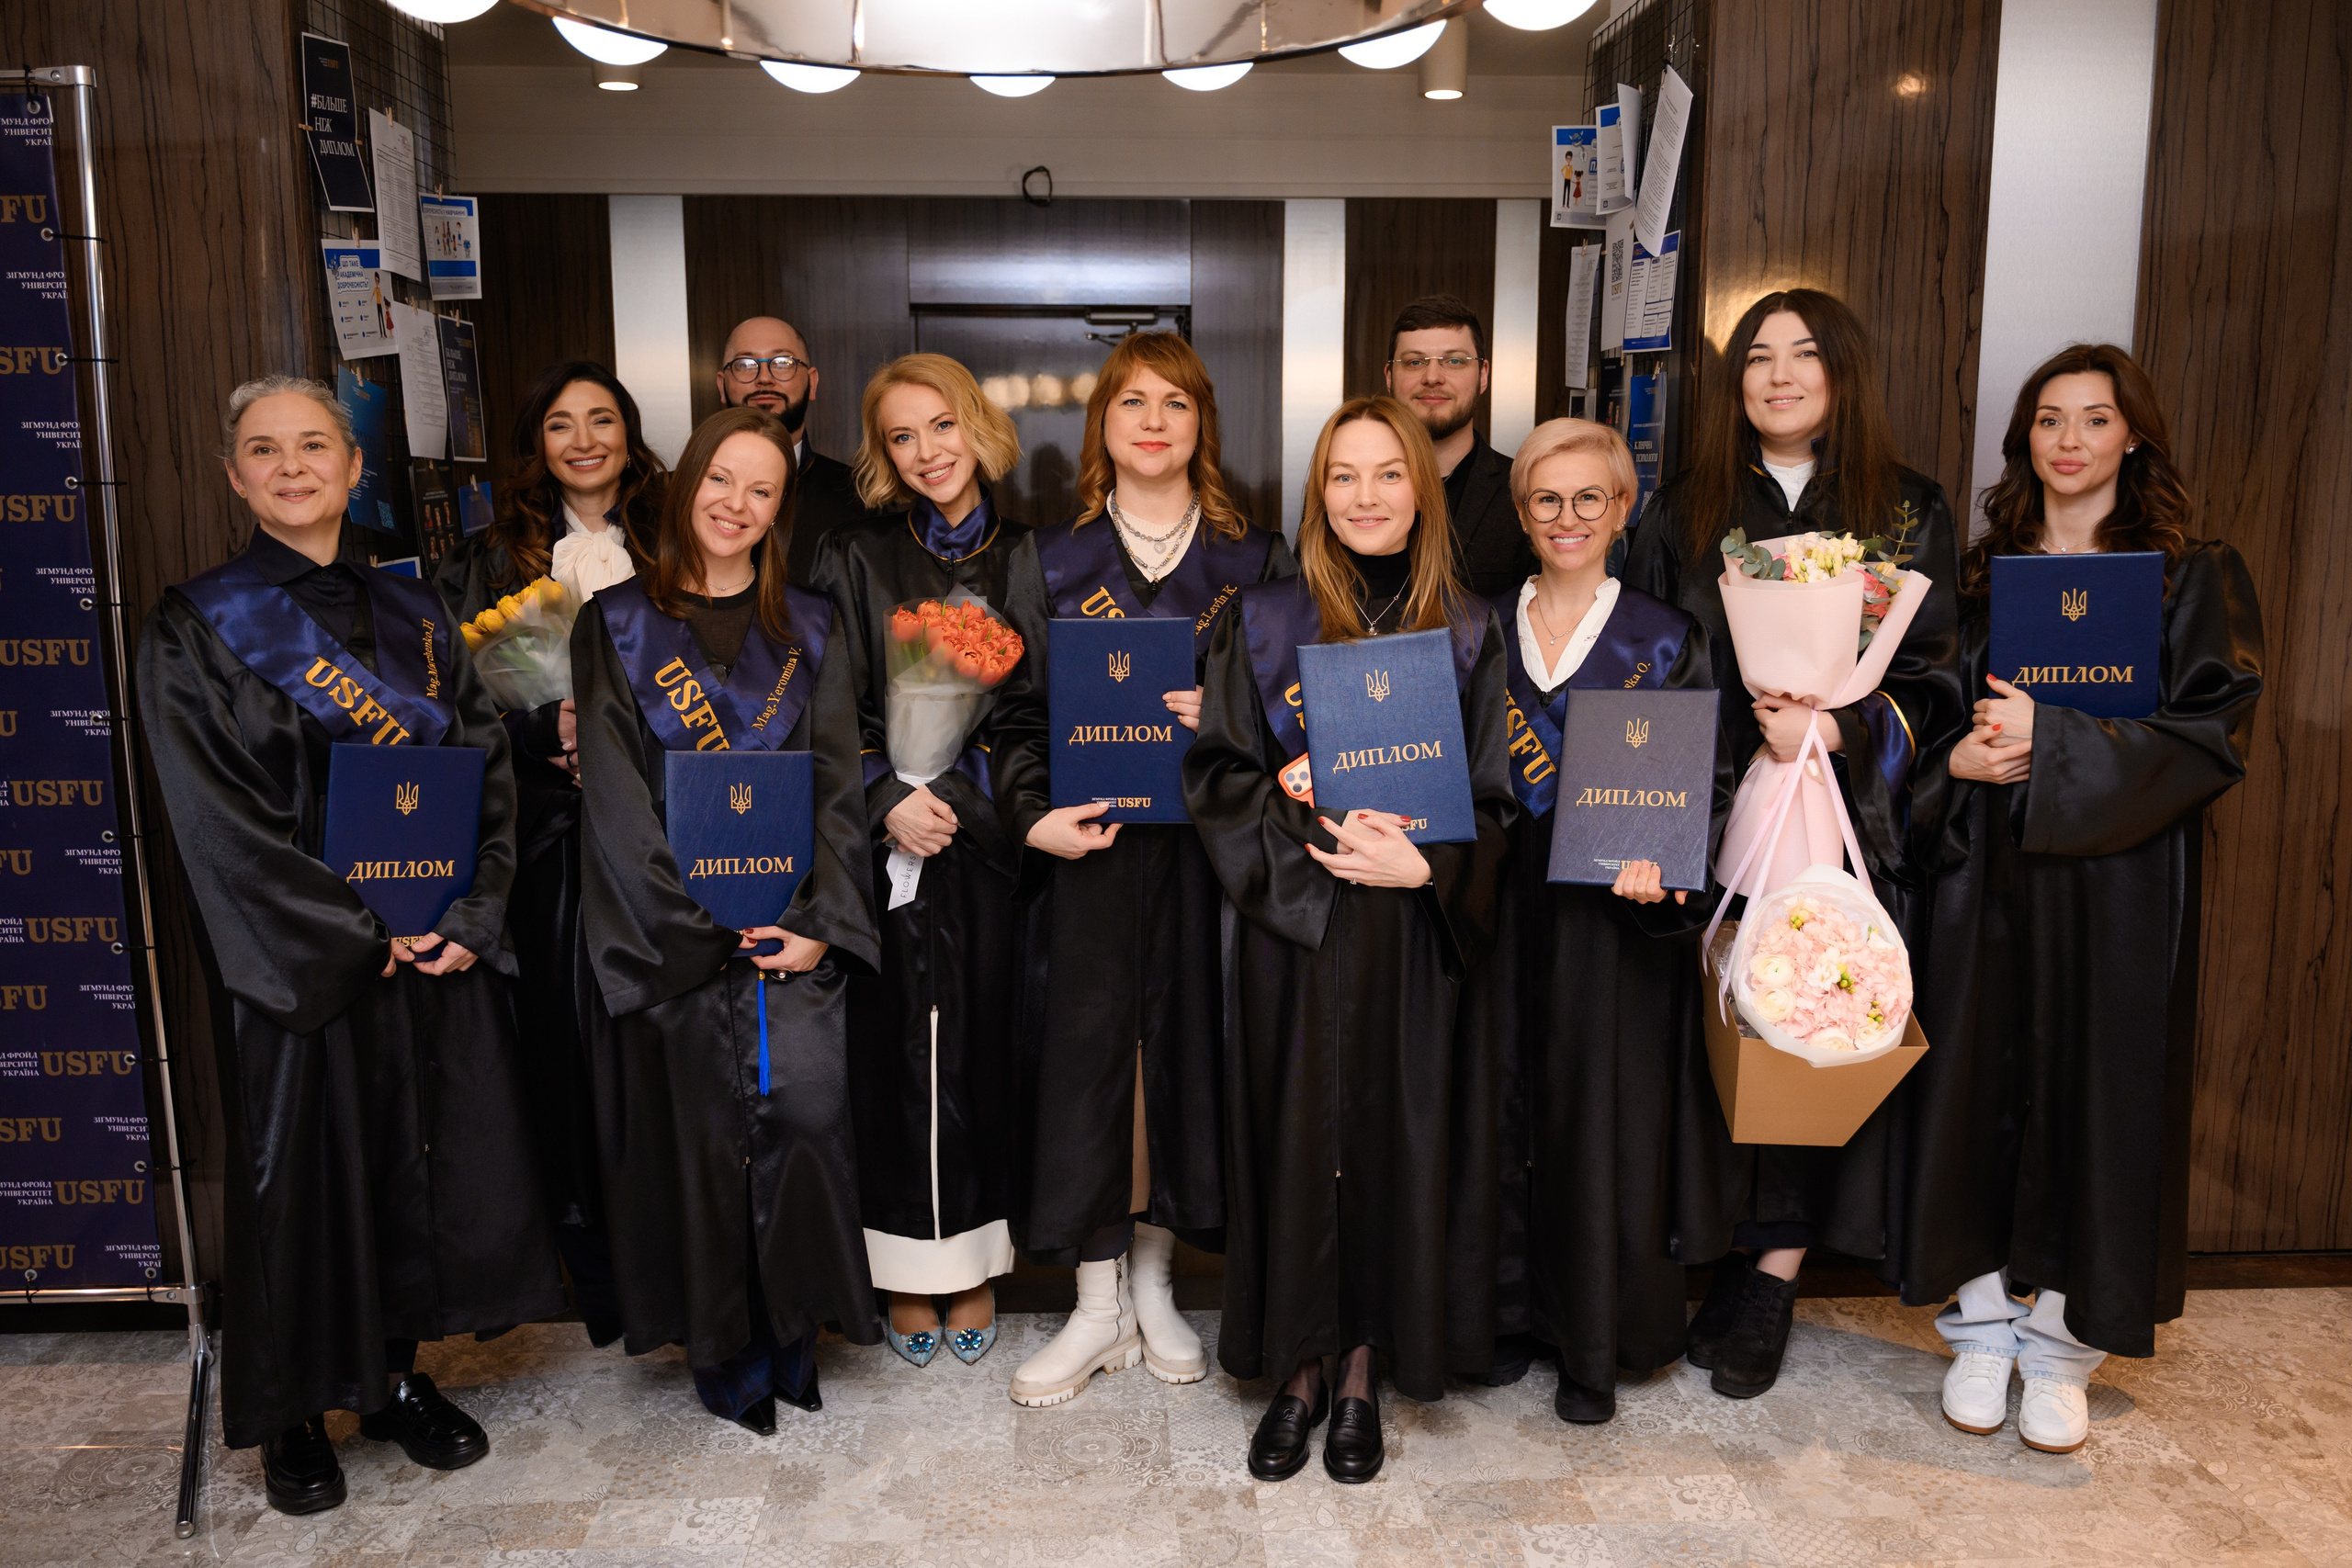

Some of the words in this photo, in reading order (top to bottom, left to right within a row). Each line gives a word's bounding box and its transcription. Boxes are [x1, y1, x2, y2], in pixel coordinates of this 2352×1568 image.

[311, 94, 348, 114] #БІЛЬШЕ
[314, 117, 333, 133] НІЖ
[25, 137, 53, 146] УКРАЇ
[319, 140, 356, 157] ДИПЛОМ
[41, 289, 68, 299] УКРАЇ
[56, 440, 82, 448] УКРАЇ
[0, 495, 76, 522] SFU
[71, 585, 96, 593] УКРАЇ
[0, 639, 90, 666] USFU
[2012, 666, 2133, 688] ДИПЛОМ
[305, 656, 410, 746] USFU
[85, 728, 111, 736] УКРАЇ
[1069, 725, 1173, 746] ДИПЛОМ
[1506, 688, 1556, 784] SFU
[1332, 740, 1442, 773] ДИПЛОМ
[10, 780, 104, 807] USFU
[1117, 797, 1151, 808] USFU
[1577, 788, 1688, 807] ДИПЛОМ
[346, 860, 455, 884] ДИПЛОМ
[689, 856, 794, 880] ДИПЛОМ
[900, 855, 917, 898] FLOWERS
[25, 917, 118, 942] USFU
[0, 986, 47, 1010] FU
[7, 1051, 38, 1059] ФРОЙД
[40, 1051, 133, 1077] USFU
[22, 1180, 52, 1189] ФРОЙД
[54, 1179, 145, 1204] USFU
